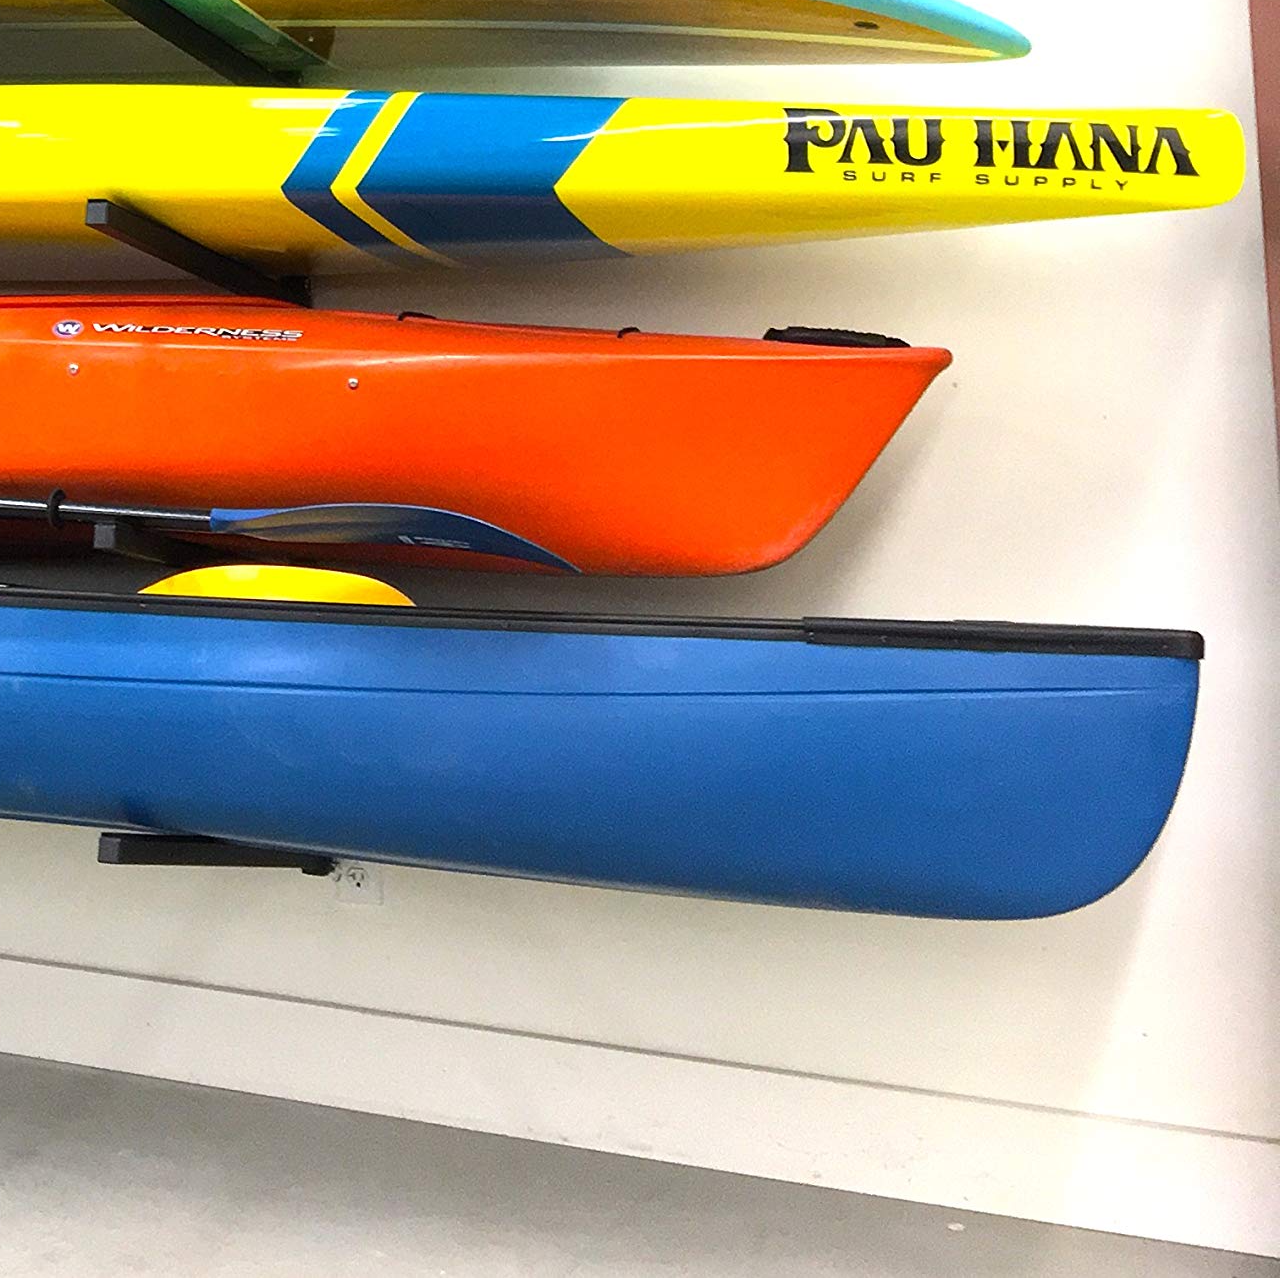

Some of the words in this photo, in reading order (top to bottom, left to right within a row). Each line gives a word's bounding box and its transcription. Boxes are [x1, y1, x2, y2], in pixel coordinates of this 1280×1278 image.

[782, 107, 946, 173] PAU
[973, 119, 1200, 177] HANA
[842, 170, 942, 183] SURF
[974, 173, 1129, 191] SUPPLY
